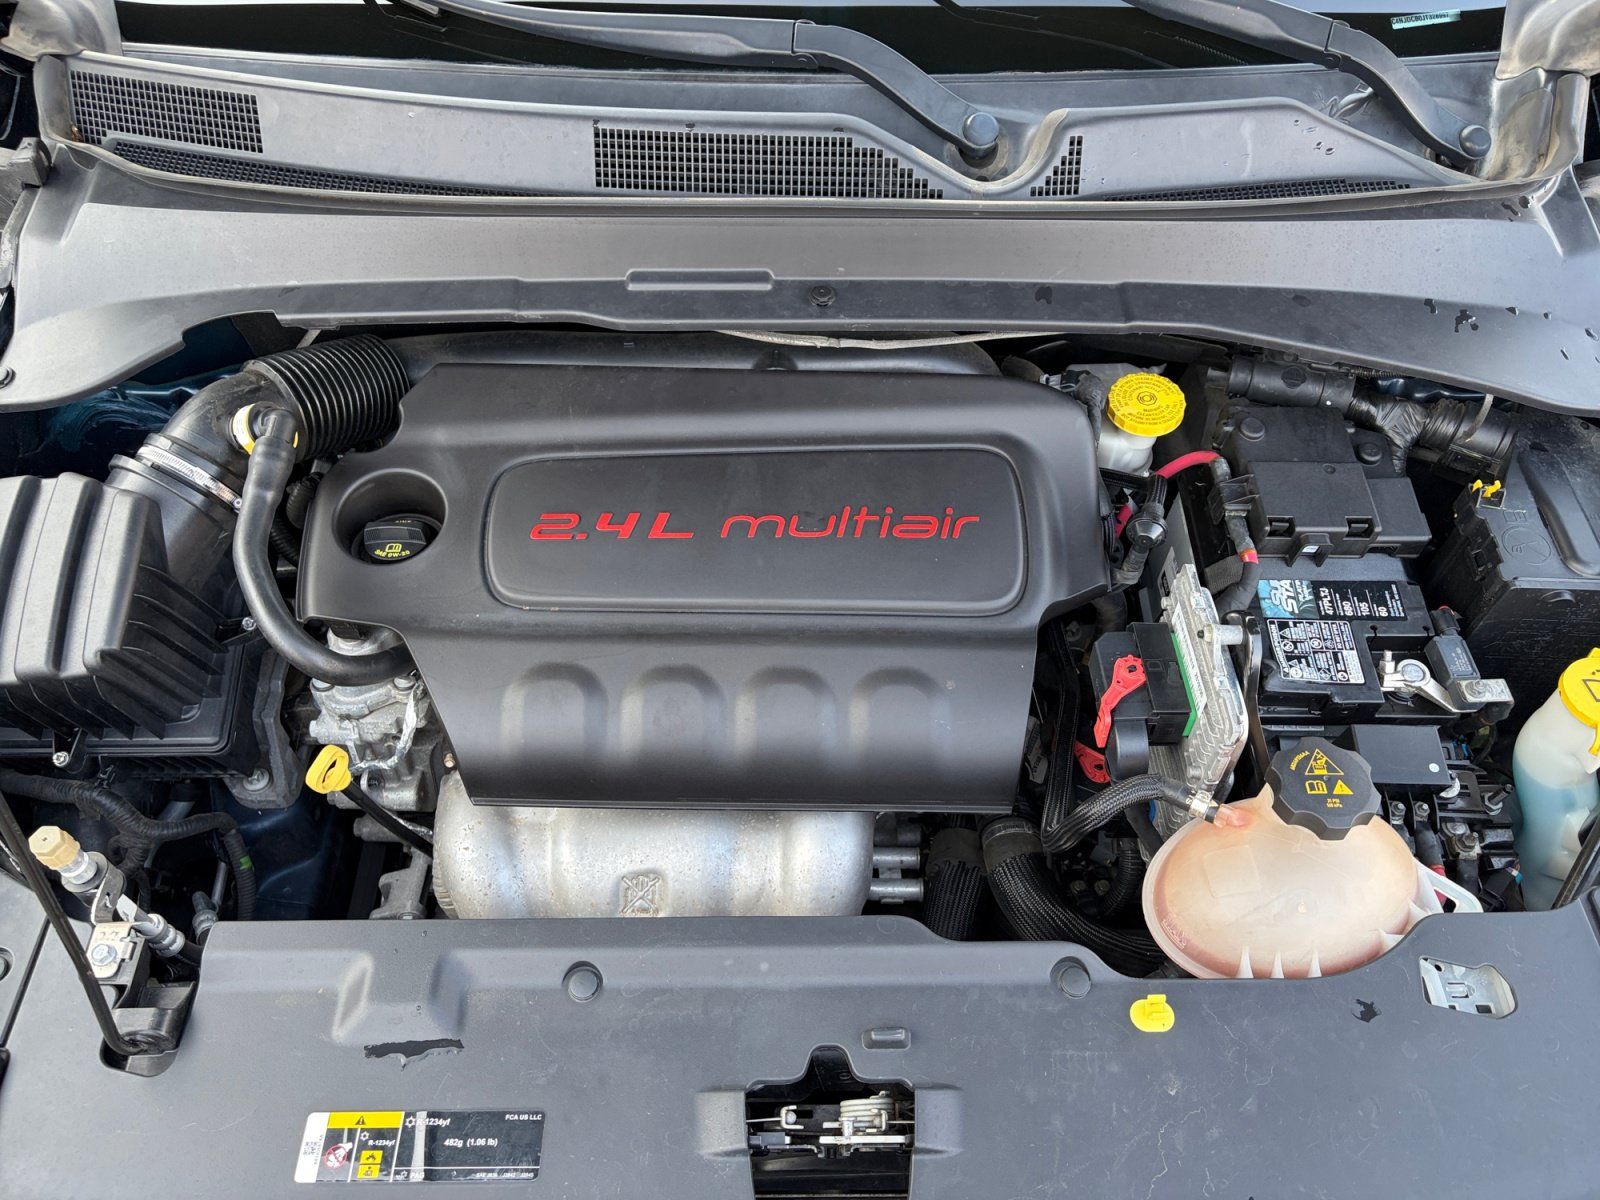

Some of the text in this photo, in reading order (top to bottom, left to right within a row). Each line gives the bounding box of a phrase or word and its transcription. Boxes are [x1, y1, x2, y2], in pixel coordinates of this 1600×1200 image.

[721, 505, 980, 538] multiair
[374, 549, 387, 557] SAE
[1343, 601, 1354, 616] 680
[1360, 602, 1371, 616] 105
[1379, 606, 1389, 617] 60
[416, 1117, 451, 1128] R-1234yf
[487, 1138, 498, 1148] lb)
